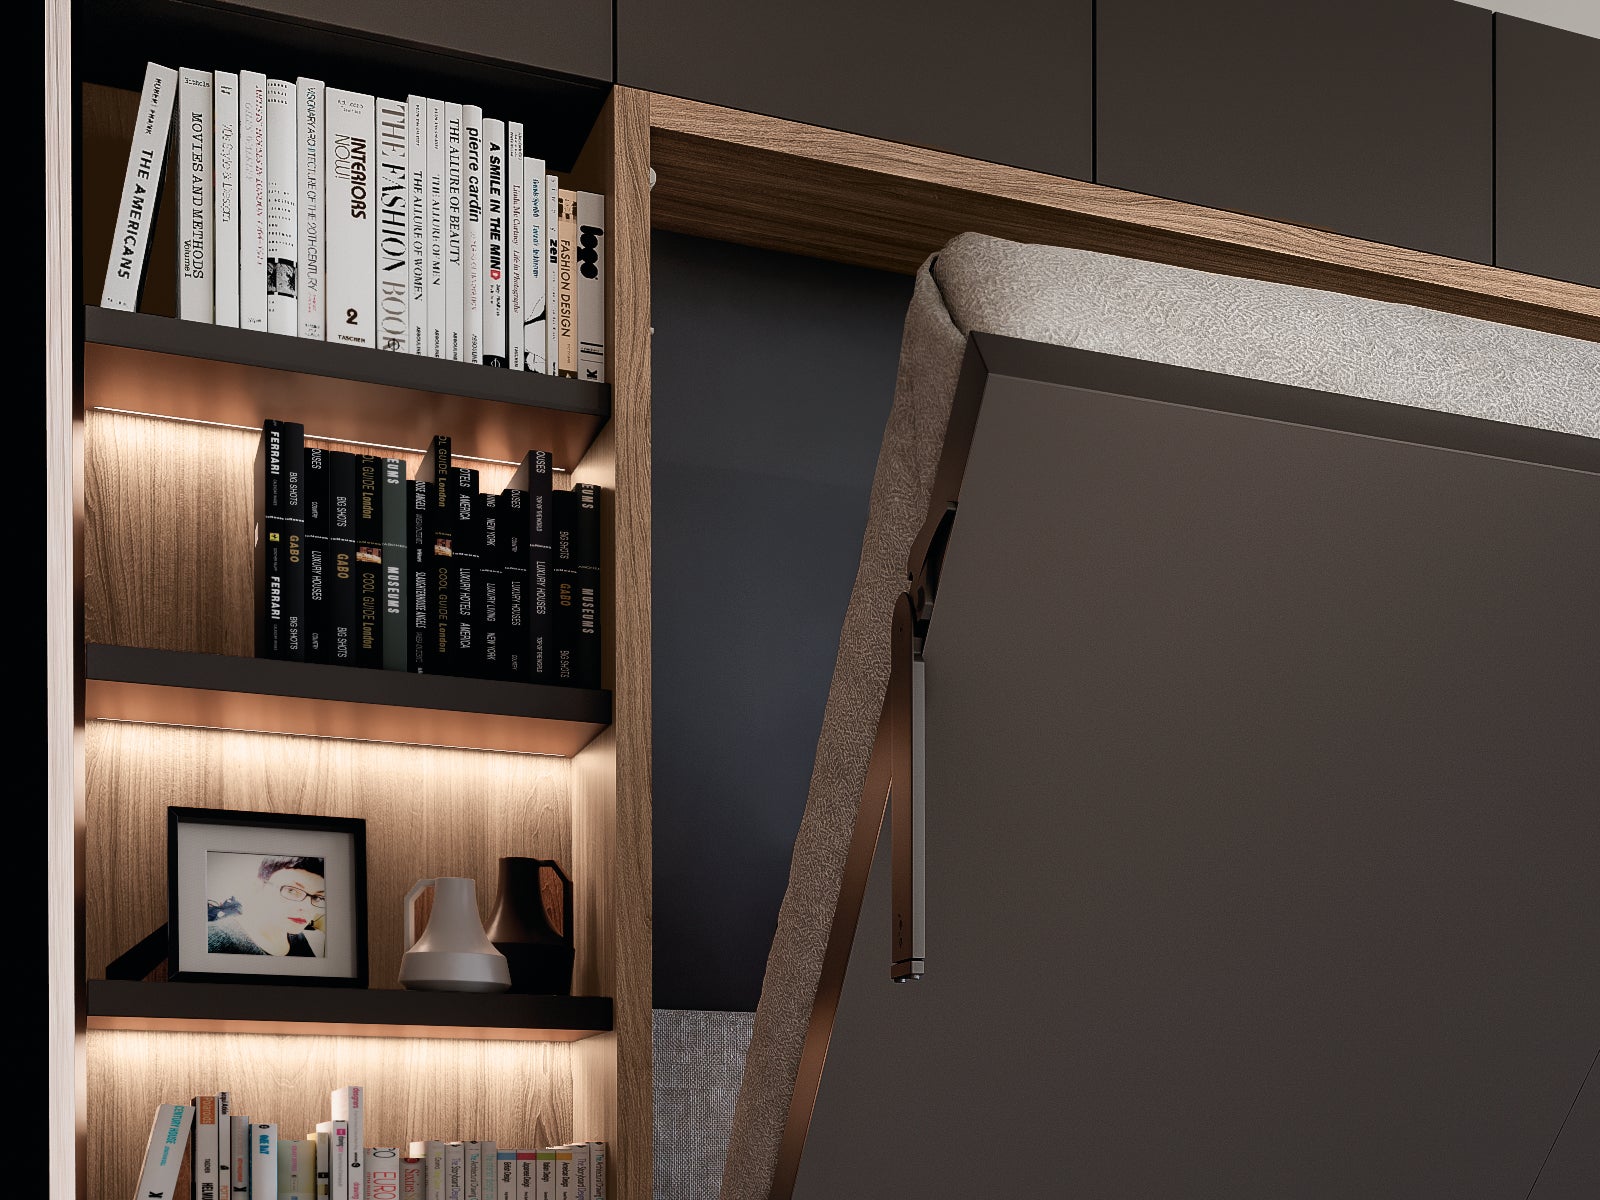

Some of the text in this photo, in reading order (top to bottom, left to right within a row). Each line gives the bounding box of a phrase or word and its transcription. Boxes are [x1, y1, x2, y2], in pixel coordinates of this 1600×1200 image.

[306, 87, 316, 128] VISIONARY
[381, 104, 406, 158] THE
[466, 126, 482, 172] pierre
[489, 142, 500, 152] A
[306, 126, 316, 190] ARCHITECTURE
[334, 133, 350, 180] NOW!
[489, 156, 500, 196] SMILE
[191, 112, 204, 279] MOVIES AND METHODS
[306, 190, 316, 203] OF
[351, 136, 366, 220] INTERIORS
[449, 119, 460, 266] THE ALLURE OF BEAUTY
[512, 184, 520, 205] Linda
[117, 149, 154, 280] THE AMERICANS
[218, 182, 233, 223] Design
[307, 204, 317, 221] THE
[380, 162, 406, 272] FASHION
[468, 175, 482, 223] cardin
[489, 199, 500, 214] IN
[413, 171, 423, 302] THE ALLURE OF WOMEN
[431, 174, 441, 286] THE ALLURE OF MEN
[489, 217, 501, 241] THE
[184, 240, 192, 272] Volume
[307, 247, 318, 291] CENTURY
[489, 243, 501, 281] MIND
[513, 263, 520, 271] in
[549, 239, 558, 264] zen
[510, 272, 520, 313] Photographs
[560, 239, 571, 338] FASHION DESIGN
[346, 308, 359, 326] 2
[338, 334, 366, 344] TASCHEN
[270, 431, 280, 475] FERRARI
[289, 472, 298, 506] BIG SHOTS
[362, 466, 375, 519] GUIDE London
[438, 448, 448, 508] GUIDE London
[336, 496, 347, 527] BIG SHOTS
[289, 535, 300, 563] GABO
[337, 553, 350, 579] GABO
[311, 550, 322, 601] LUXURY HOUSES
[387, 566, 400, 614] MUSEUMS
[536, 561, 546, 615] LUXURY HOUSES
[559, 583, 571, 607] GABO
[270, 576, 280, 620] FERRARI
[362, 572, 375, 649] COOL GUIDE London
[438, 567, 448, 653] COOL GUIDE London
[459, 567, 471, 649] LUXURY HOTELS AMERICA
[511, 580, 521, 626] LUXURY HOUSES
[581, 588, 594, 635] MUSEUMS
[289, 616, 298, 650] BIG SHOTS
[415, 611, 426, 629] ANGELS
[486, 582, 496, 661] LUXURY LIVING NEW YORK
[337, 626, 347, 658] BIG SHOTS
[168, 1105, 185, 1128] CENTURY
[351, 1087, 361, 1109] designers
[165, 1127, 179, 1145] HOUSE
[352, 1182, 361, 1200] drawing
[404, 1168, 420, 1193] Sixties
[501, 1170, 512, 1183] Design
[522, 1176, 531, 1188] Design
